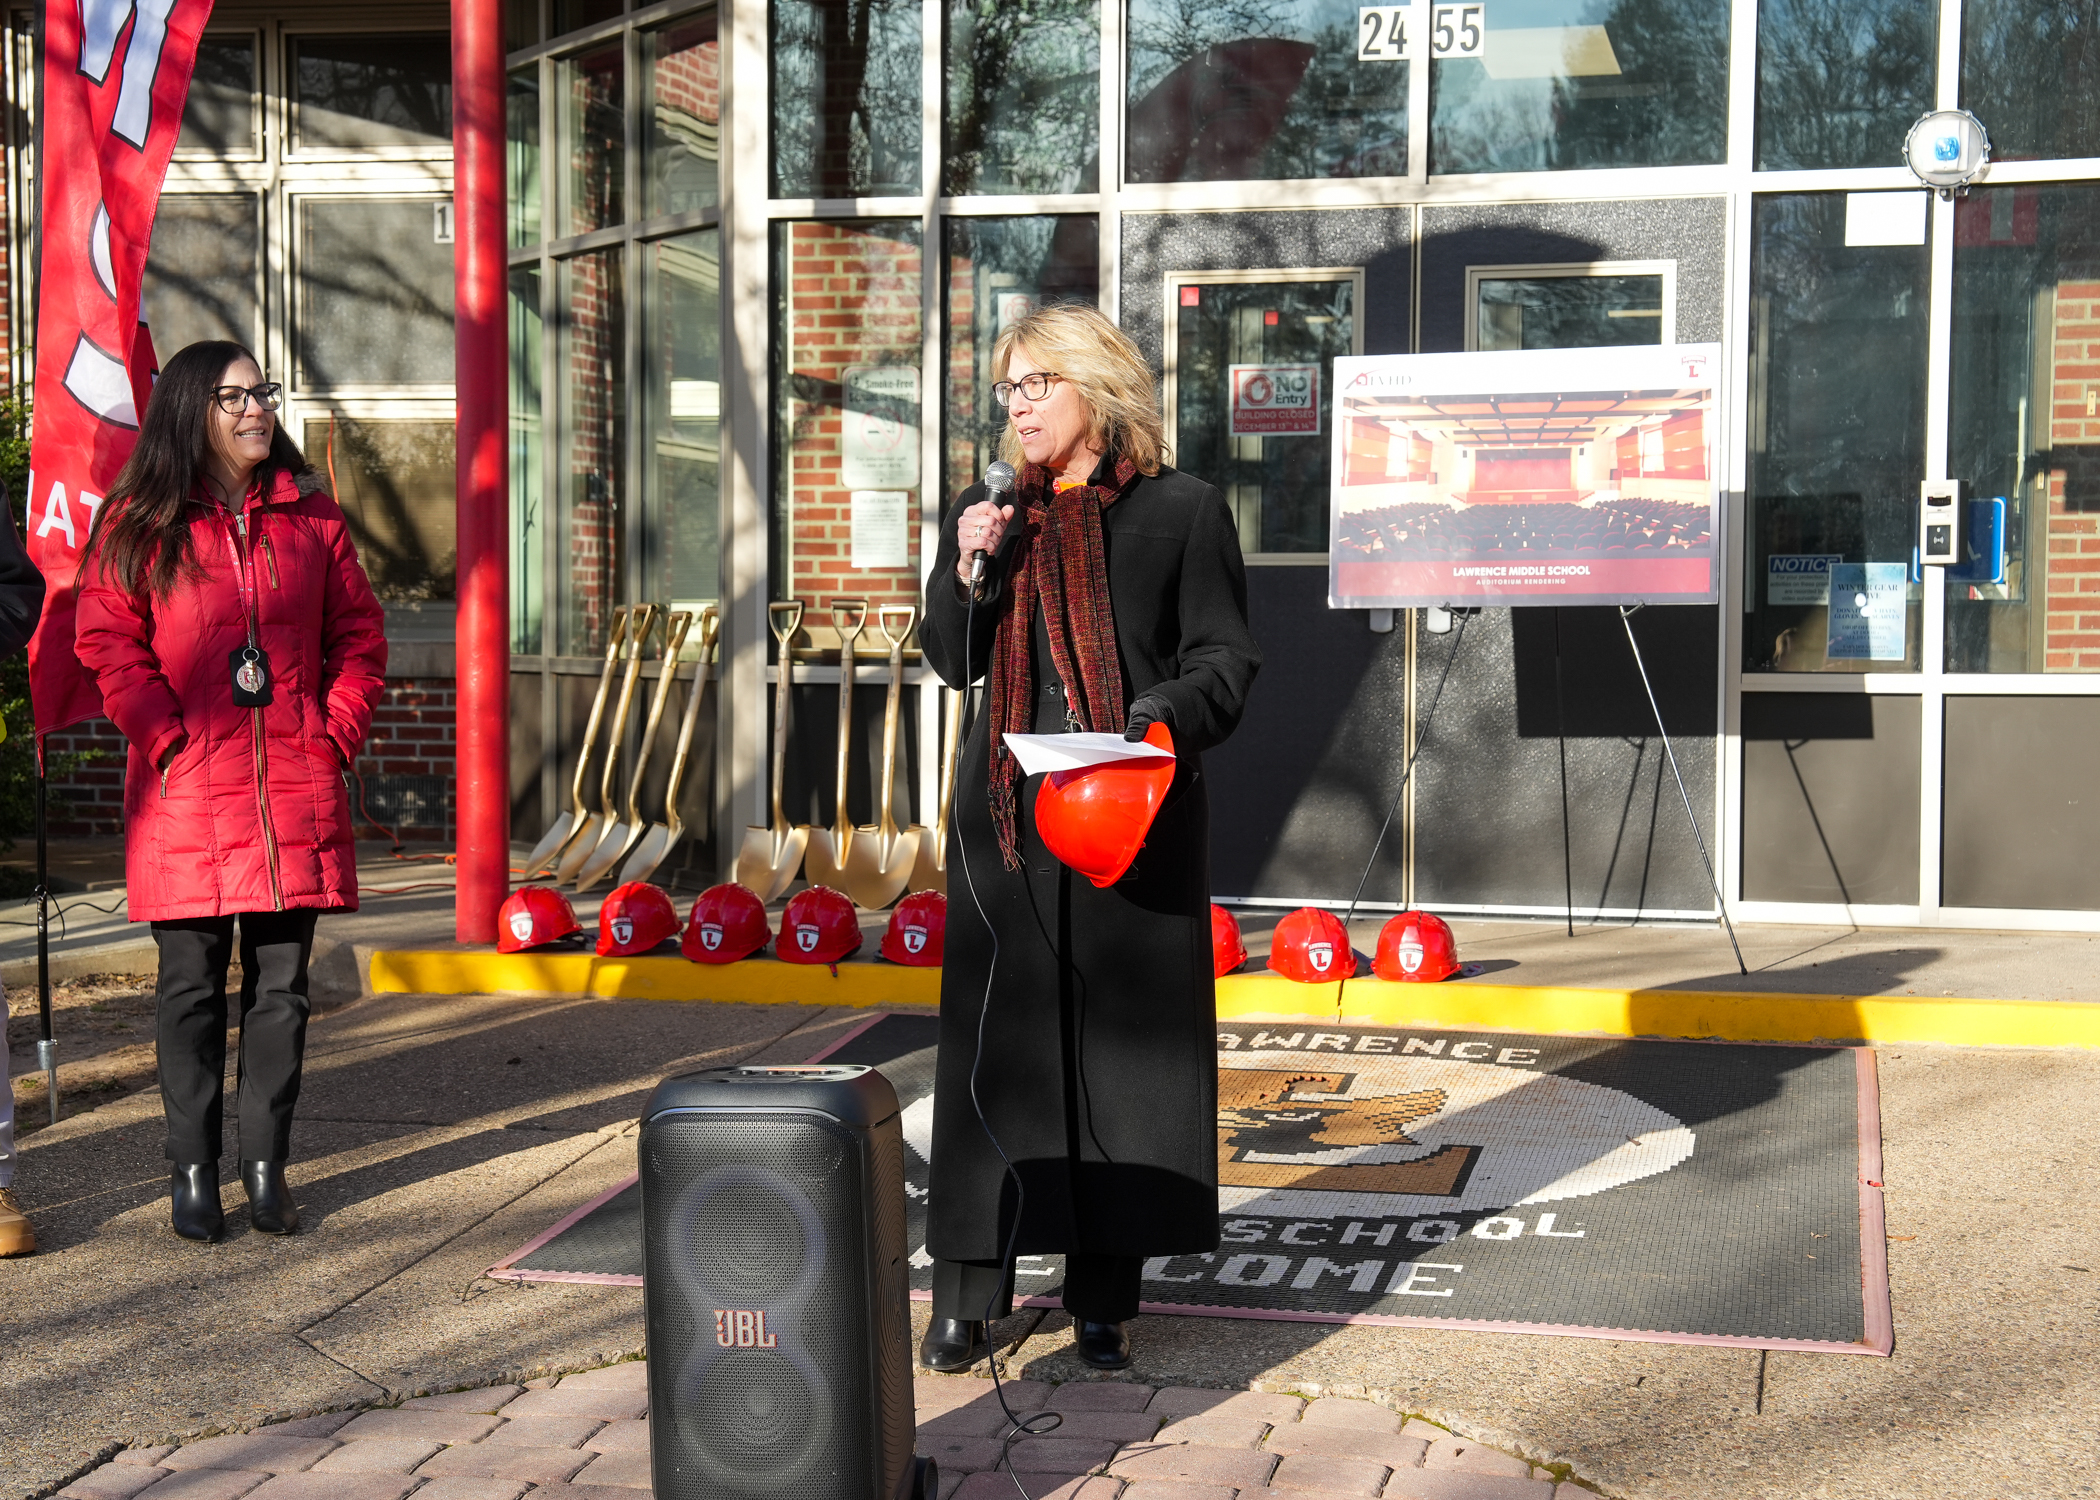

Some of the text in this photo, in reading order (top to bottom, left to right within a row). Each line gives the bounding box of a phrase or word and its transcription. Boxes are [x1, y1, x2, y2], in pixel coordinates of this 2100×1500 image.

[1362, 8, 1480, 55] 24 55
[437, 205, 450, 239] 1
[1275, 376, 1307, 392] NO
[1275, 394, 1307, 406] Entry
[1235, 410, 1315, 419] BUILDING CLOSED
[1234, 423, 1277, 431] DECEMBER
[1453, 565, 1591, 577] LAWRENCE MIDDLE SCHOOL
[1772, 558, 1838, 572] NOTICE
[1837, 584, 1872, 592] WINTER
[517, 923, 528, 937] L
[617, 927, 628, 941] L
[706, 932, 716, 947] L
[802, 933, 812, 949] L
[909, 934, 920, 950] L
[1316, 952, 1327, 967] L
[1406, 953, 1416, 968] L
[1217, 1032, 1541, 1064] AWRENCE
[1221, 1212, 1586, 1246] SCHOOL
[714, 1310, 777, 1348] JBL
